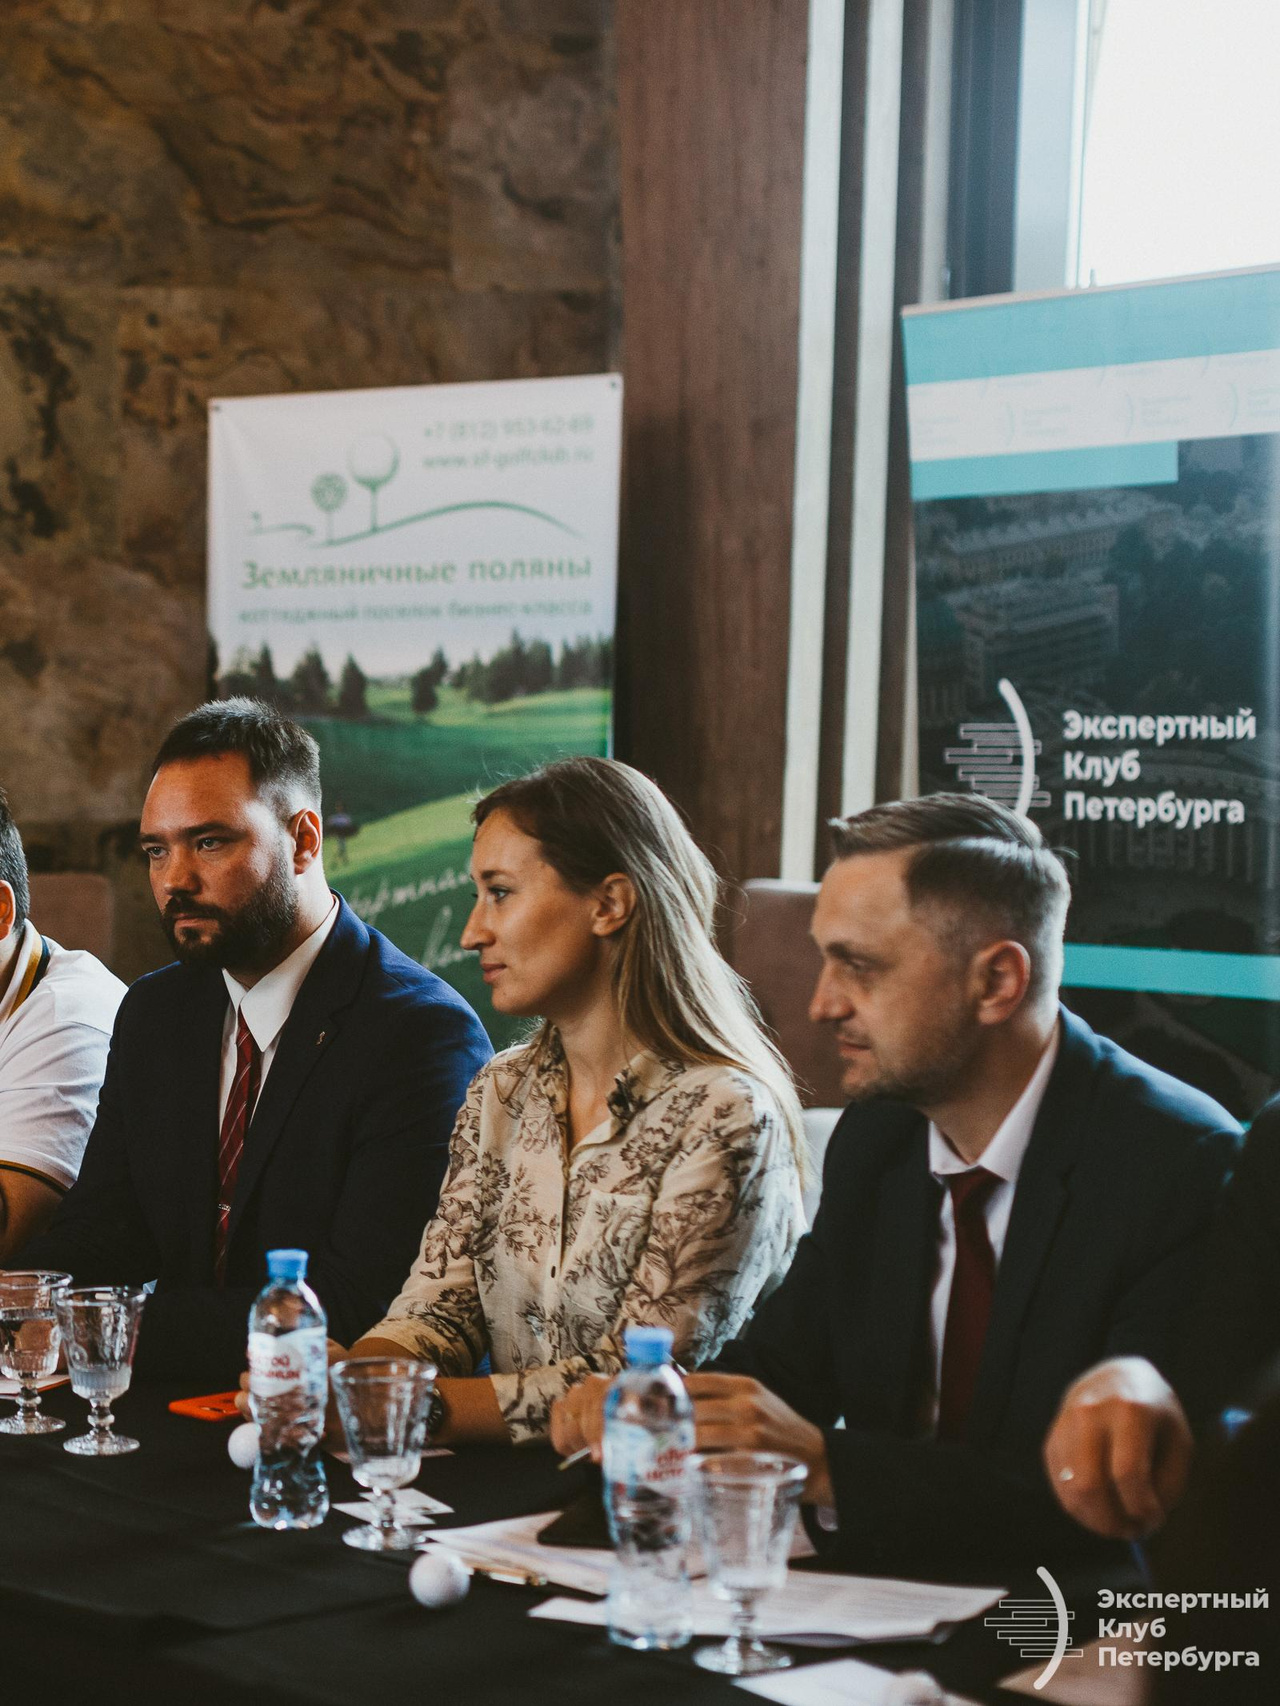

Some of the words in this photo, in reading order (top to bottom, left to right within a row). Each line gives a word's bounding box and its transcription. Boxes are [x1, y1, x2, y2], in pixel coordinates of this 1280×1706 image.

[241, 559, 457, 591] Земляничные
[468, 556, 592, 581] поляны
[1062, 707, 1257, 746] Экспертный
[1063, 748, 1142, 787] Клуб
[1063, 789, 1246, 830] Петербурга
